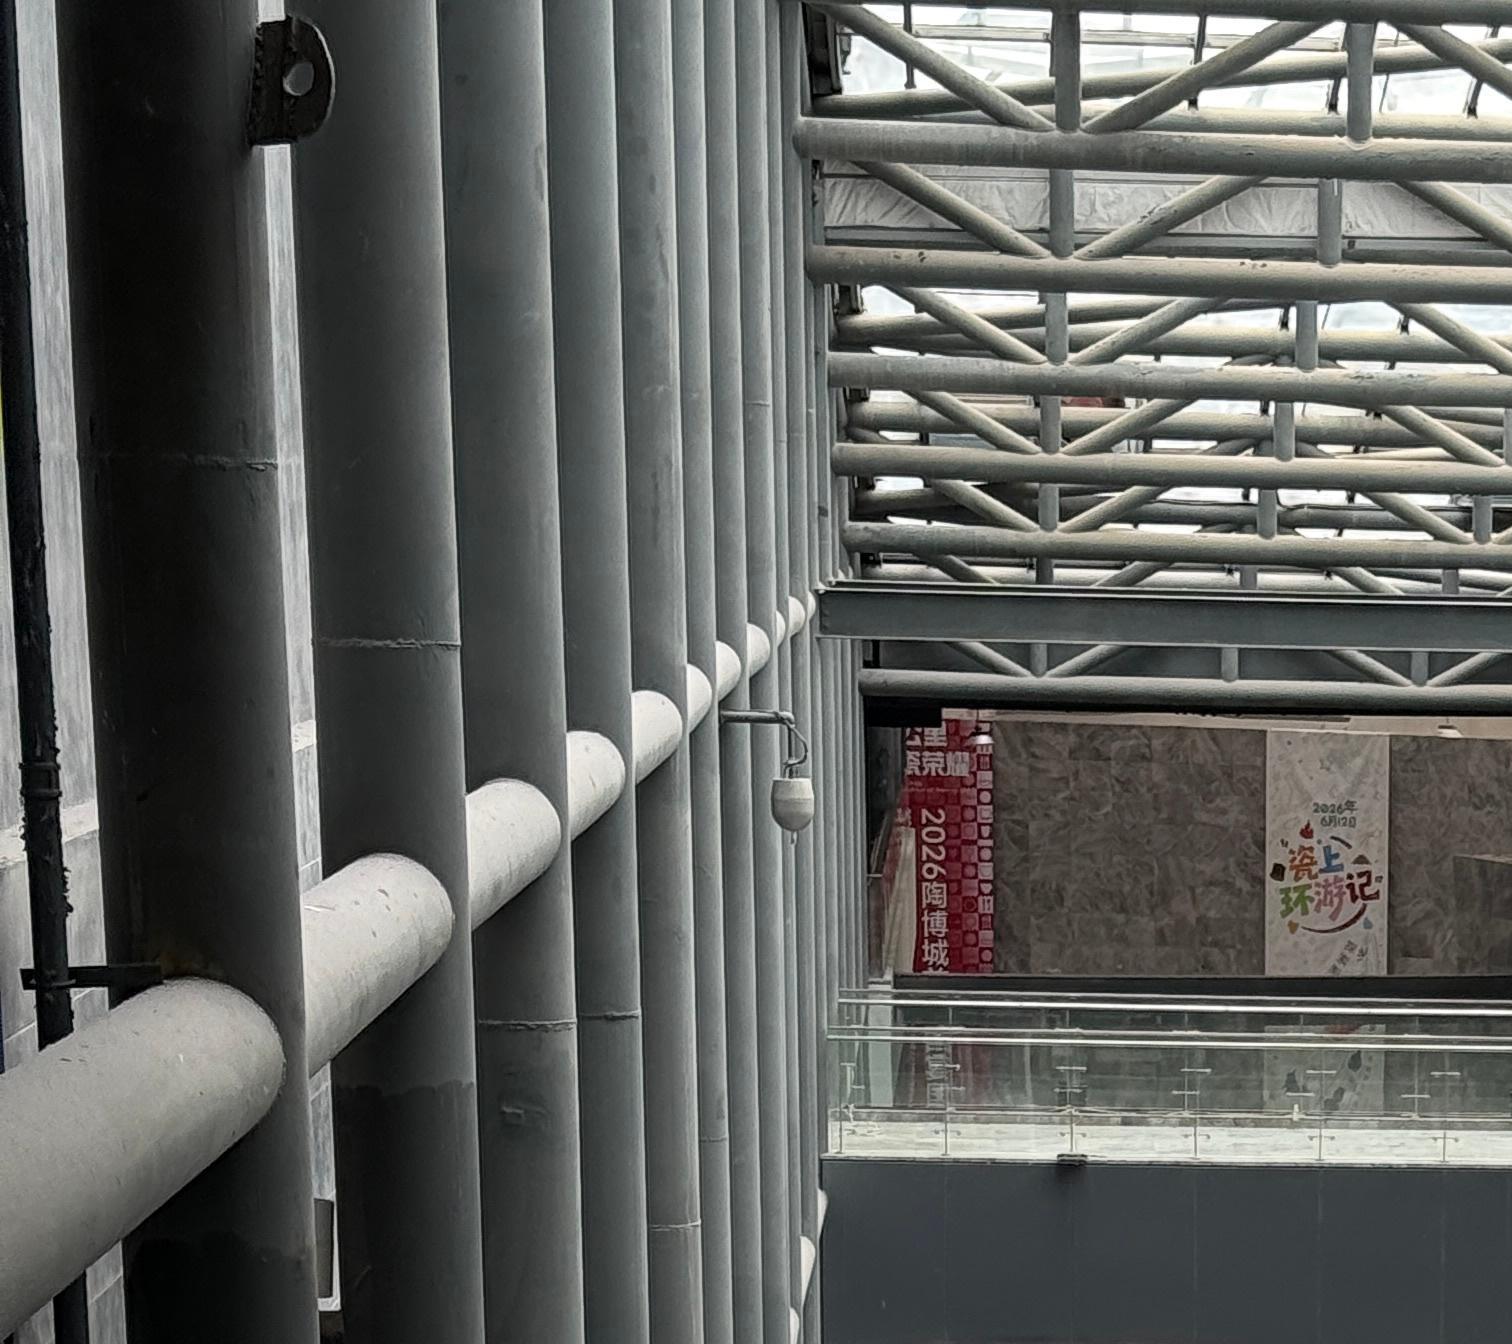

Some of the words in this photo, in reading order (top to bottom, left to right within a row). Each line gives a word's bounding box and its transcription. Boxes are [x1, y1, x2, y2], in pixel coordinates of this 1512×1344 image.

[920, 808, 950, 973] 2026陶博城
[1279, 870, 1380, 922] 环游记
